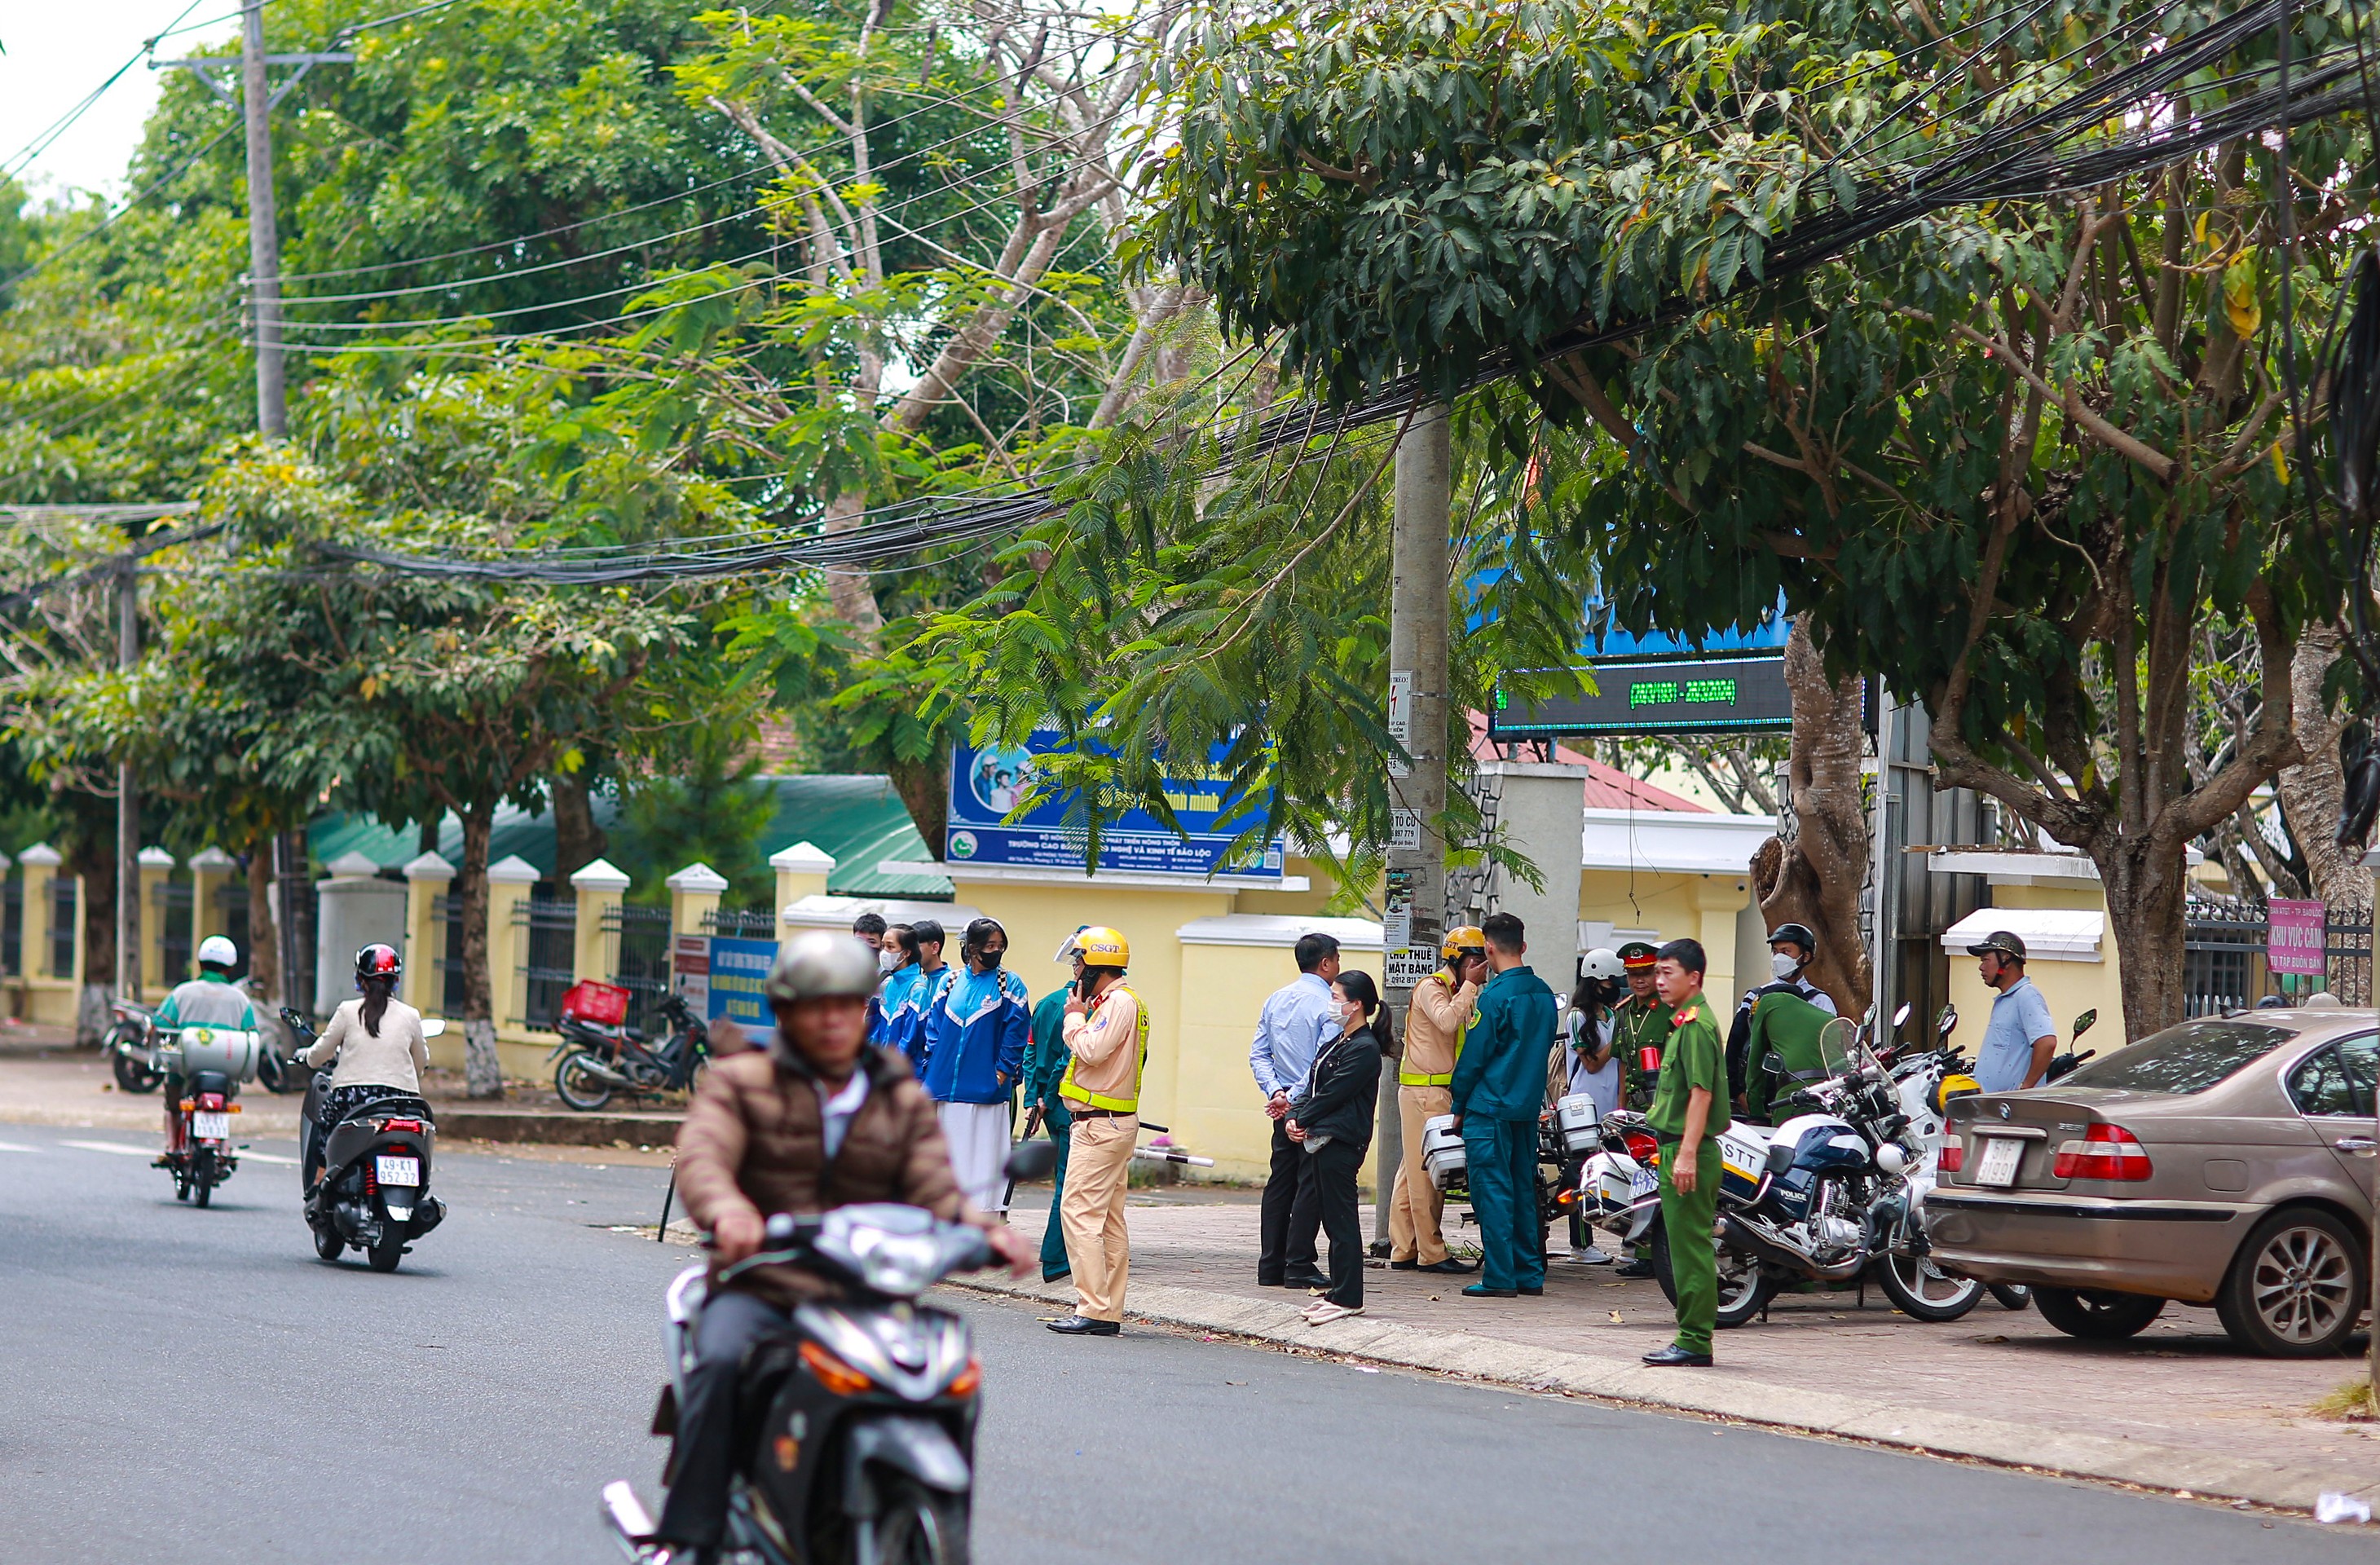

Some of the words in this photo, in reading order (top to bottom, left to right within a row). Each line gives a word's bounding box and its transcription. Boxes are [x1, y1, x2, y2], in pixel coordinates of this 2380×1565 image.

[1041, 841, 1059, 850] CAO
[1134, 846, 1145, 854] VÀ
[2271, 925, 2286, 946] KHU
[2288, 923, 2303, 952] VỰC
[2305, 919, 2321, 949] CẤM
[1091, 944, 1120, 954] CSGT
[1408, 947, 1432, 960] THUÊ
[2270, 955, 2278, 968] TỤ
[2279, 954, 2290, 968] TẬP
[2292, 954, 2307, 968] BUÔN
[2309, 956, 2321, 969] BÁN
[1389, 962, 1406, 976] MẶT
[1408, 960, 1433, 975] BẰNG
[1780, 1189, 1807, 1201] POLICE
